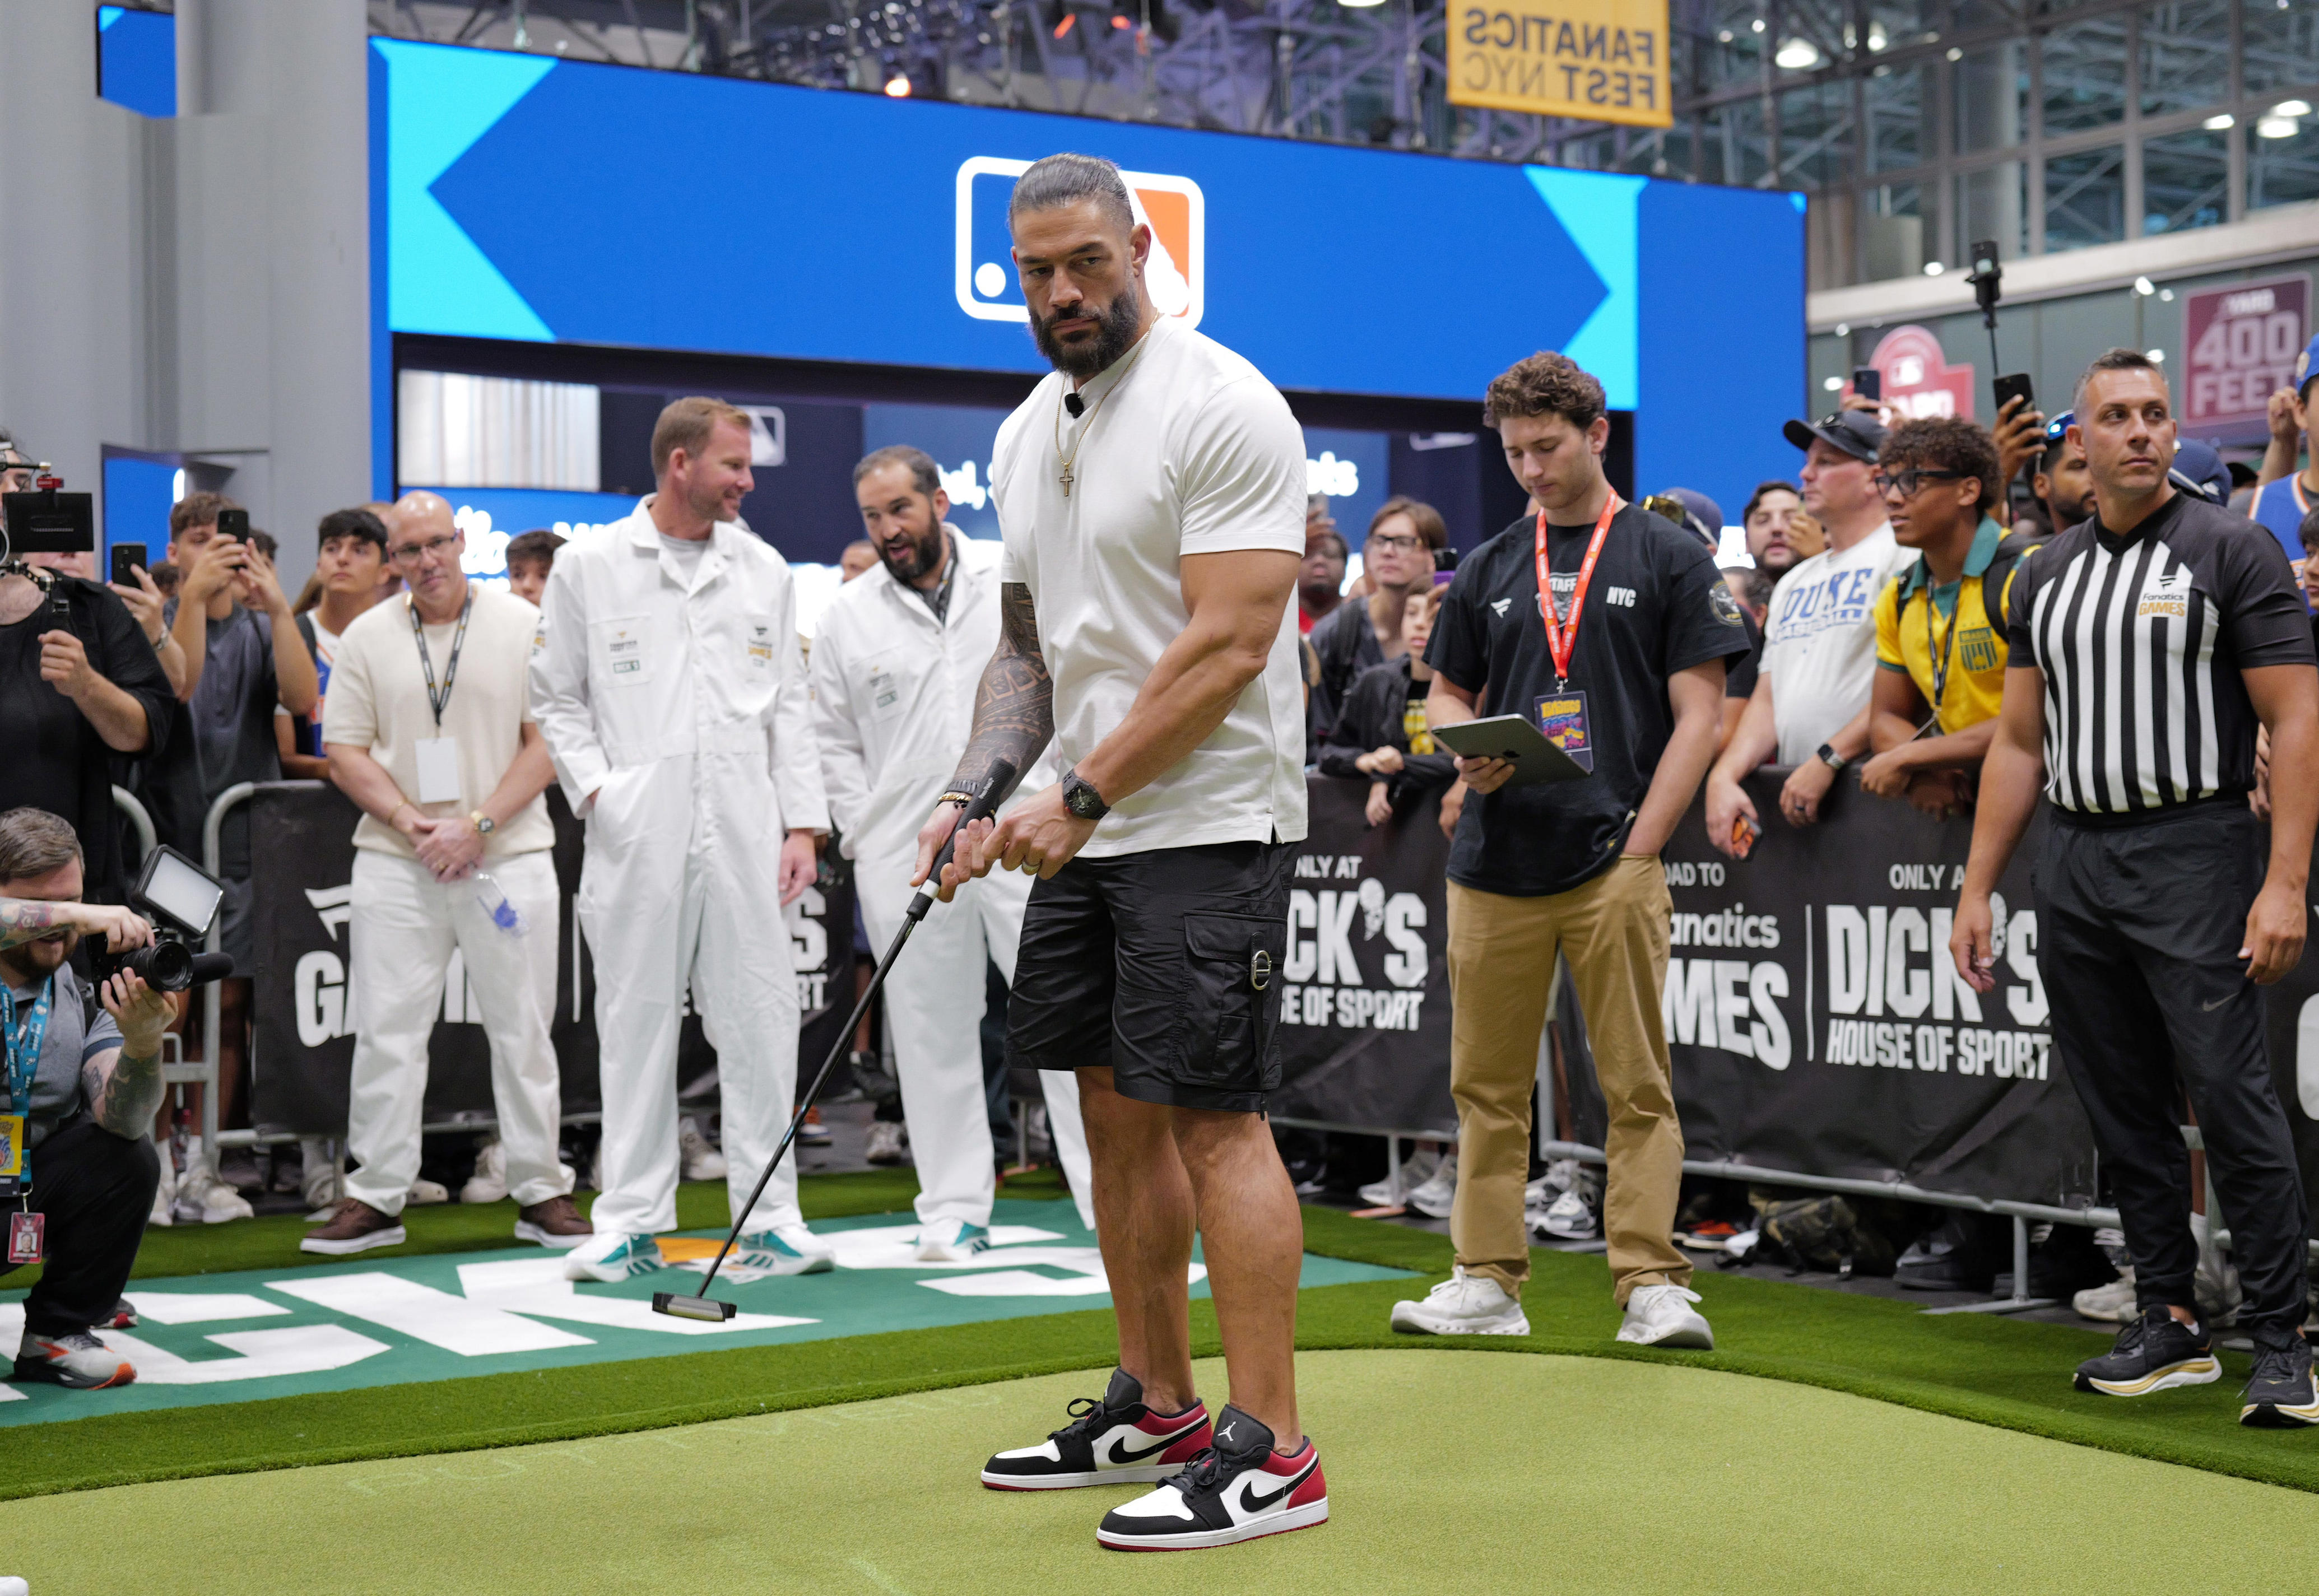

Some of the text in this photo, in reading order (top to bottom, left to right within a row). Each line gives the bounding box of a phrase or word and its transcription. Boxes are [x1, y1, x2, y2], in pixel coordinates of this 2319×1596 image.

[2191, 311, 2298, 370] 400
[2192, 366, 2298, 417] FEET
[1549, 578, 1578, 593] TAFF
[1606, 585, 1637, 608] NYC
[1779, 568, 1874, 626] DUKE
[2143, 593, 2185, 601] Fanatics
[2139, 602, 2185, 617] GAMES
[1294, 854, 1363, 879] NLY AT
[1665, 862, 1726, 887] AD TO
[1889, 864, 1965, 891] ONLY A
[1282, 877, 1429, 988] CK'S
[1670, 902, 1781, 949] anatics
[1826, 891, 2050, 1027] DICK'S
[1303, 986, 1334, 1027] OF
[1336, 988, 1425, 1031] SPORT
[1661, 957, 1792, 1071] MES
[1825, 1018, 2052, 1081] HOUSE OF SPORT
[0, 1224, 1208, 1400] CK'S
